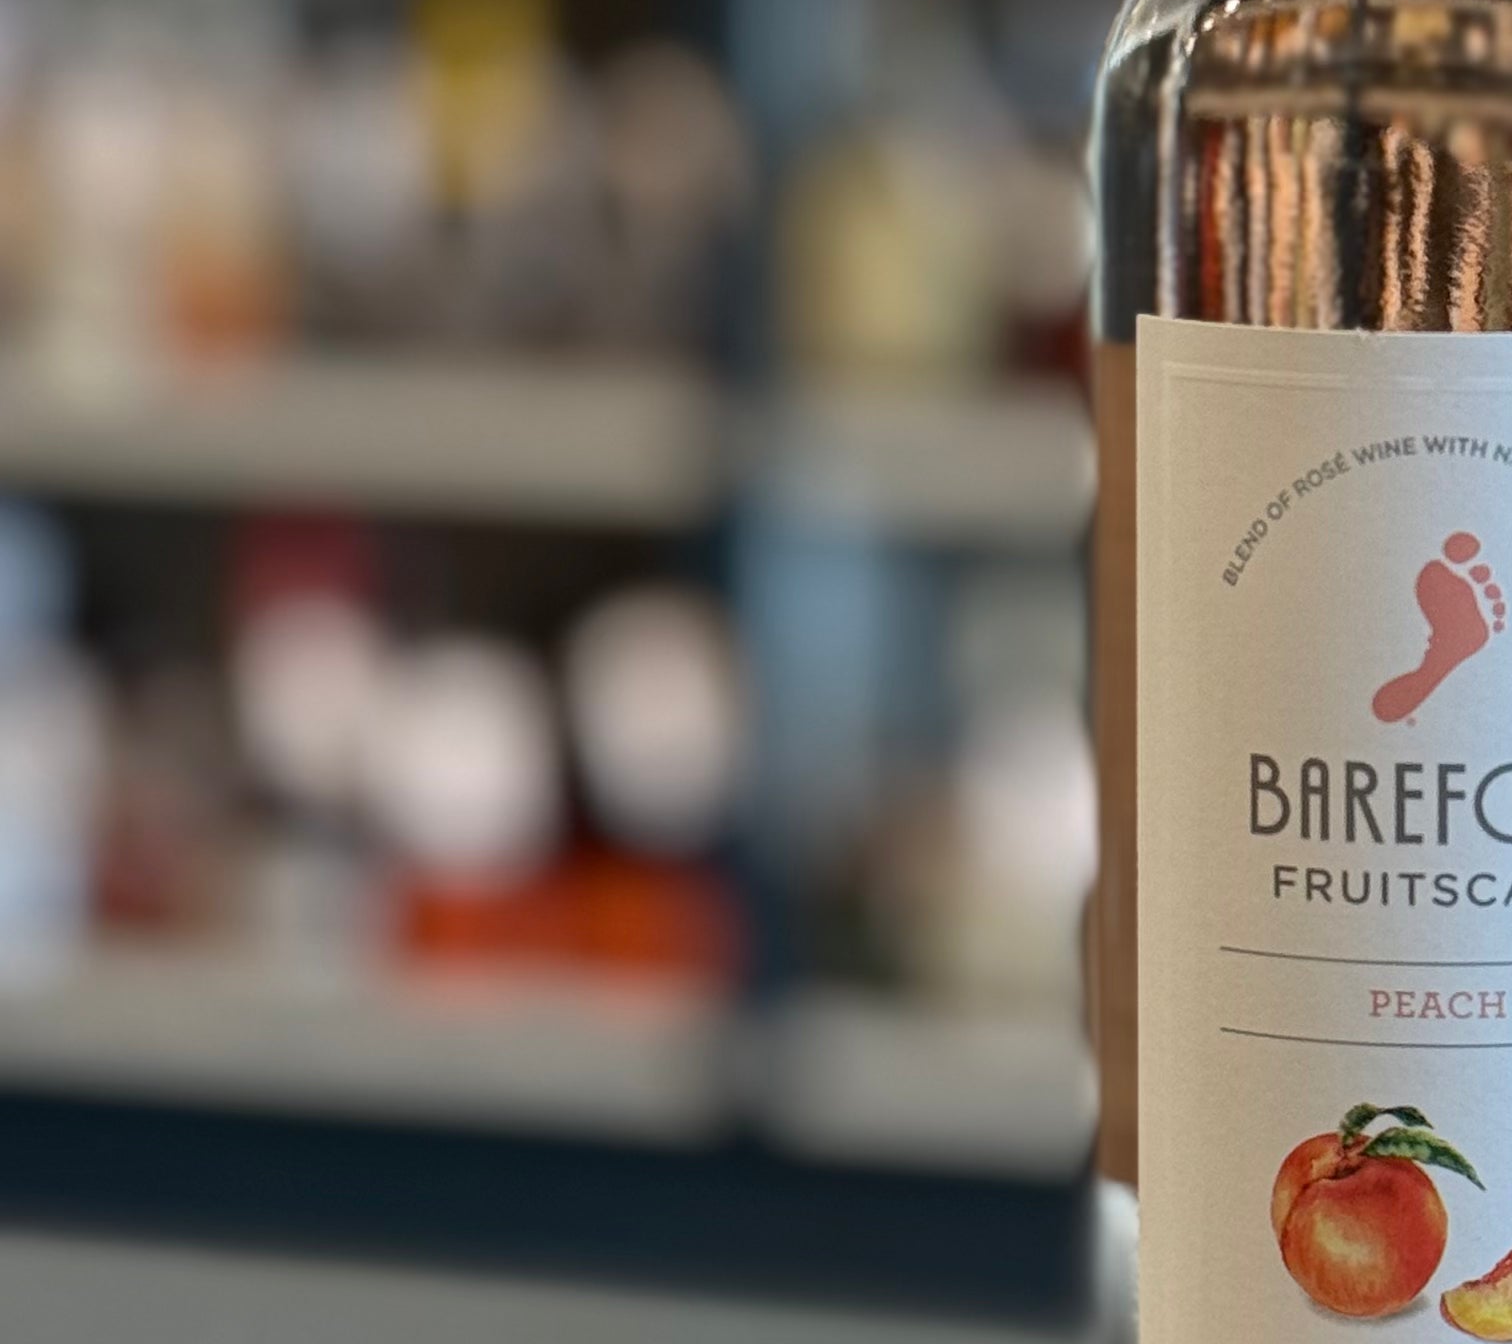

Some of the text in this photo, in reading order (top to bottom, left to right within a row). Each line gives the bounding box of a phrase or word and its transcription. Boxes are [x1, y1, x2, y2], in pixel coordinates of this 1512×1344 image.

[1222, 518, 1268, 586] BLEND
[1267, 489, 1293, 520] OF
[1352, 436, 1417, 464] WINE
[1423, 435, 1488, 458] WITH
[1369, 989, 1507, 1019] PEACH
